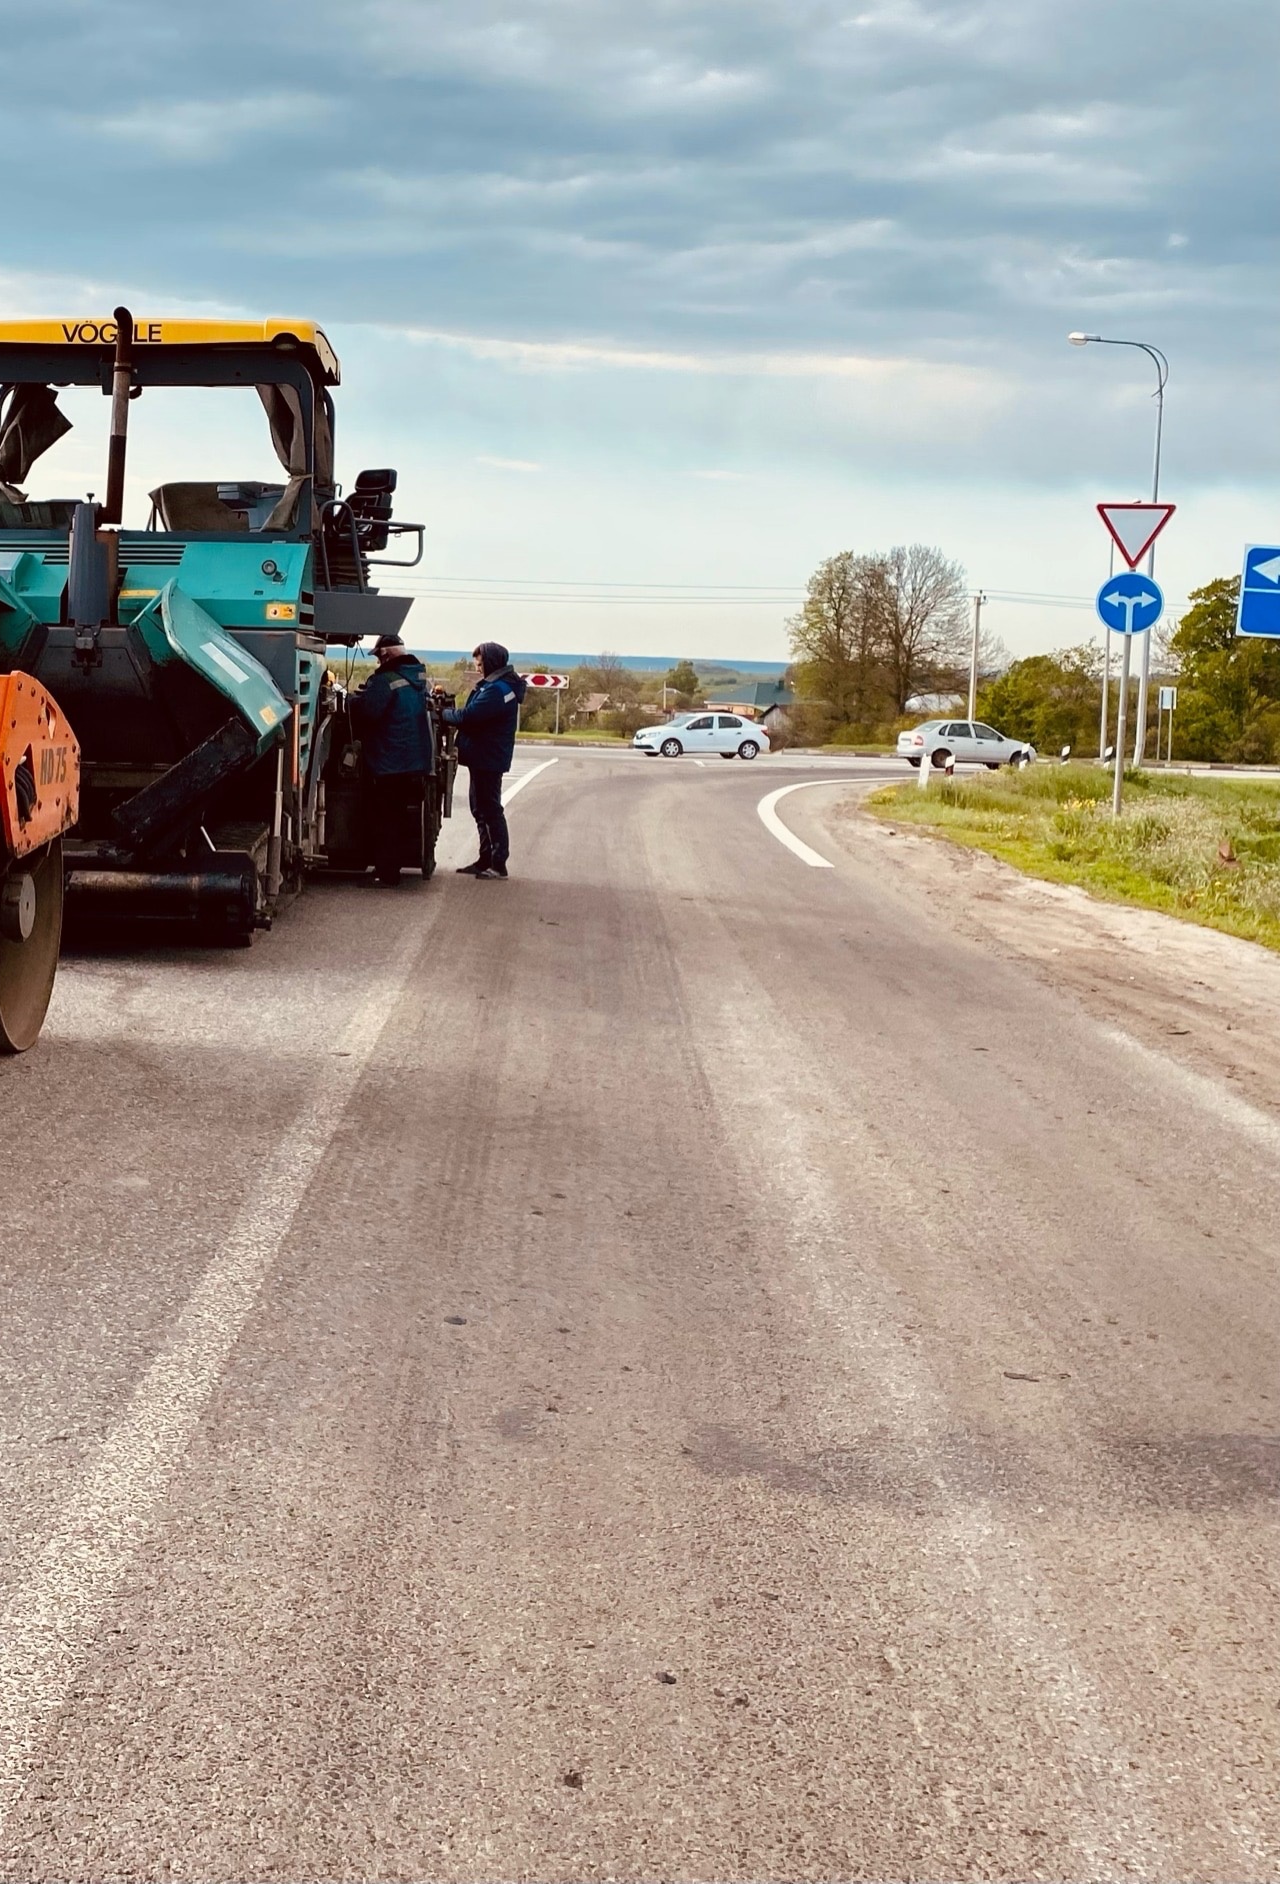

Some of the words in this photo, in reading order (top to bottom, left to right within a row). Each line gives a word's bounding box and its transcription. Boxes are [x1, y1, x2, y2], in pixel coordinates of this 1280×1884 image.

[62, 320, 162, 343] VÖGLE
[40, 748, 55, 785] HD
[55, 746, 67, 783] 75
